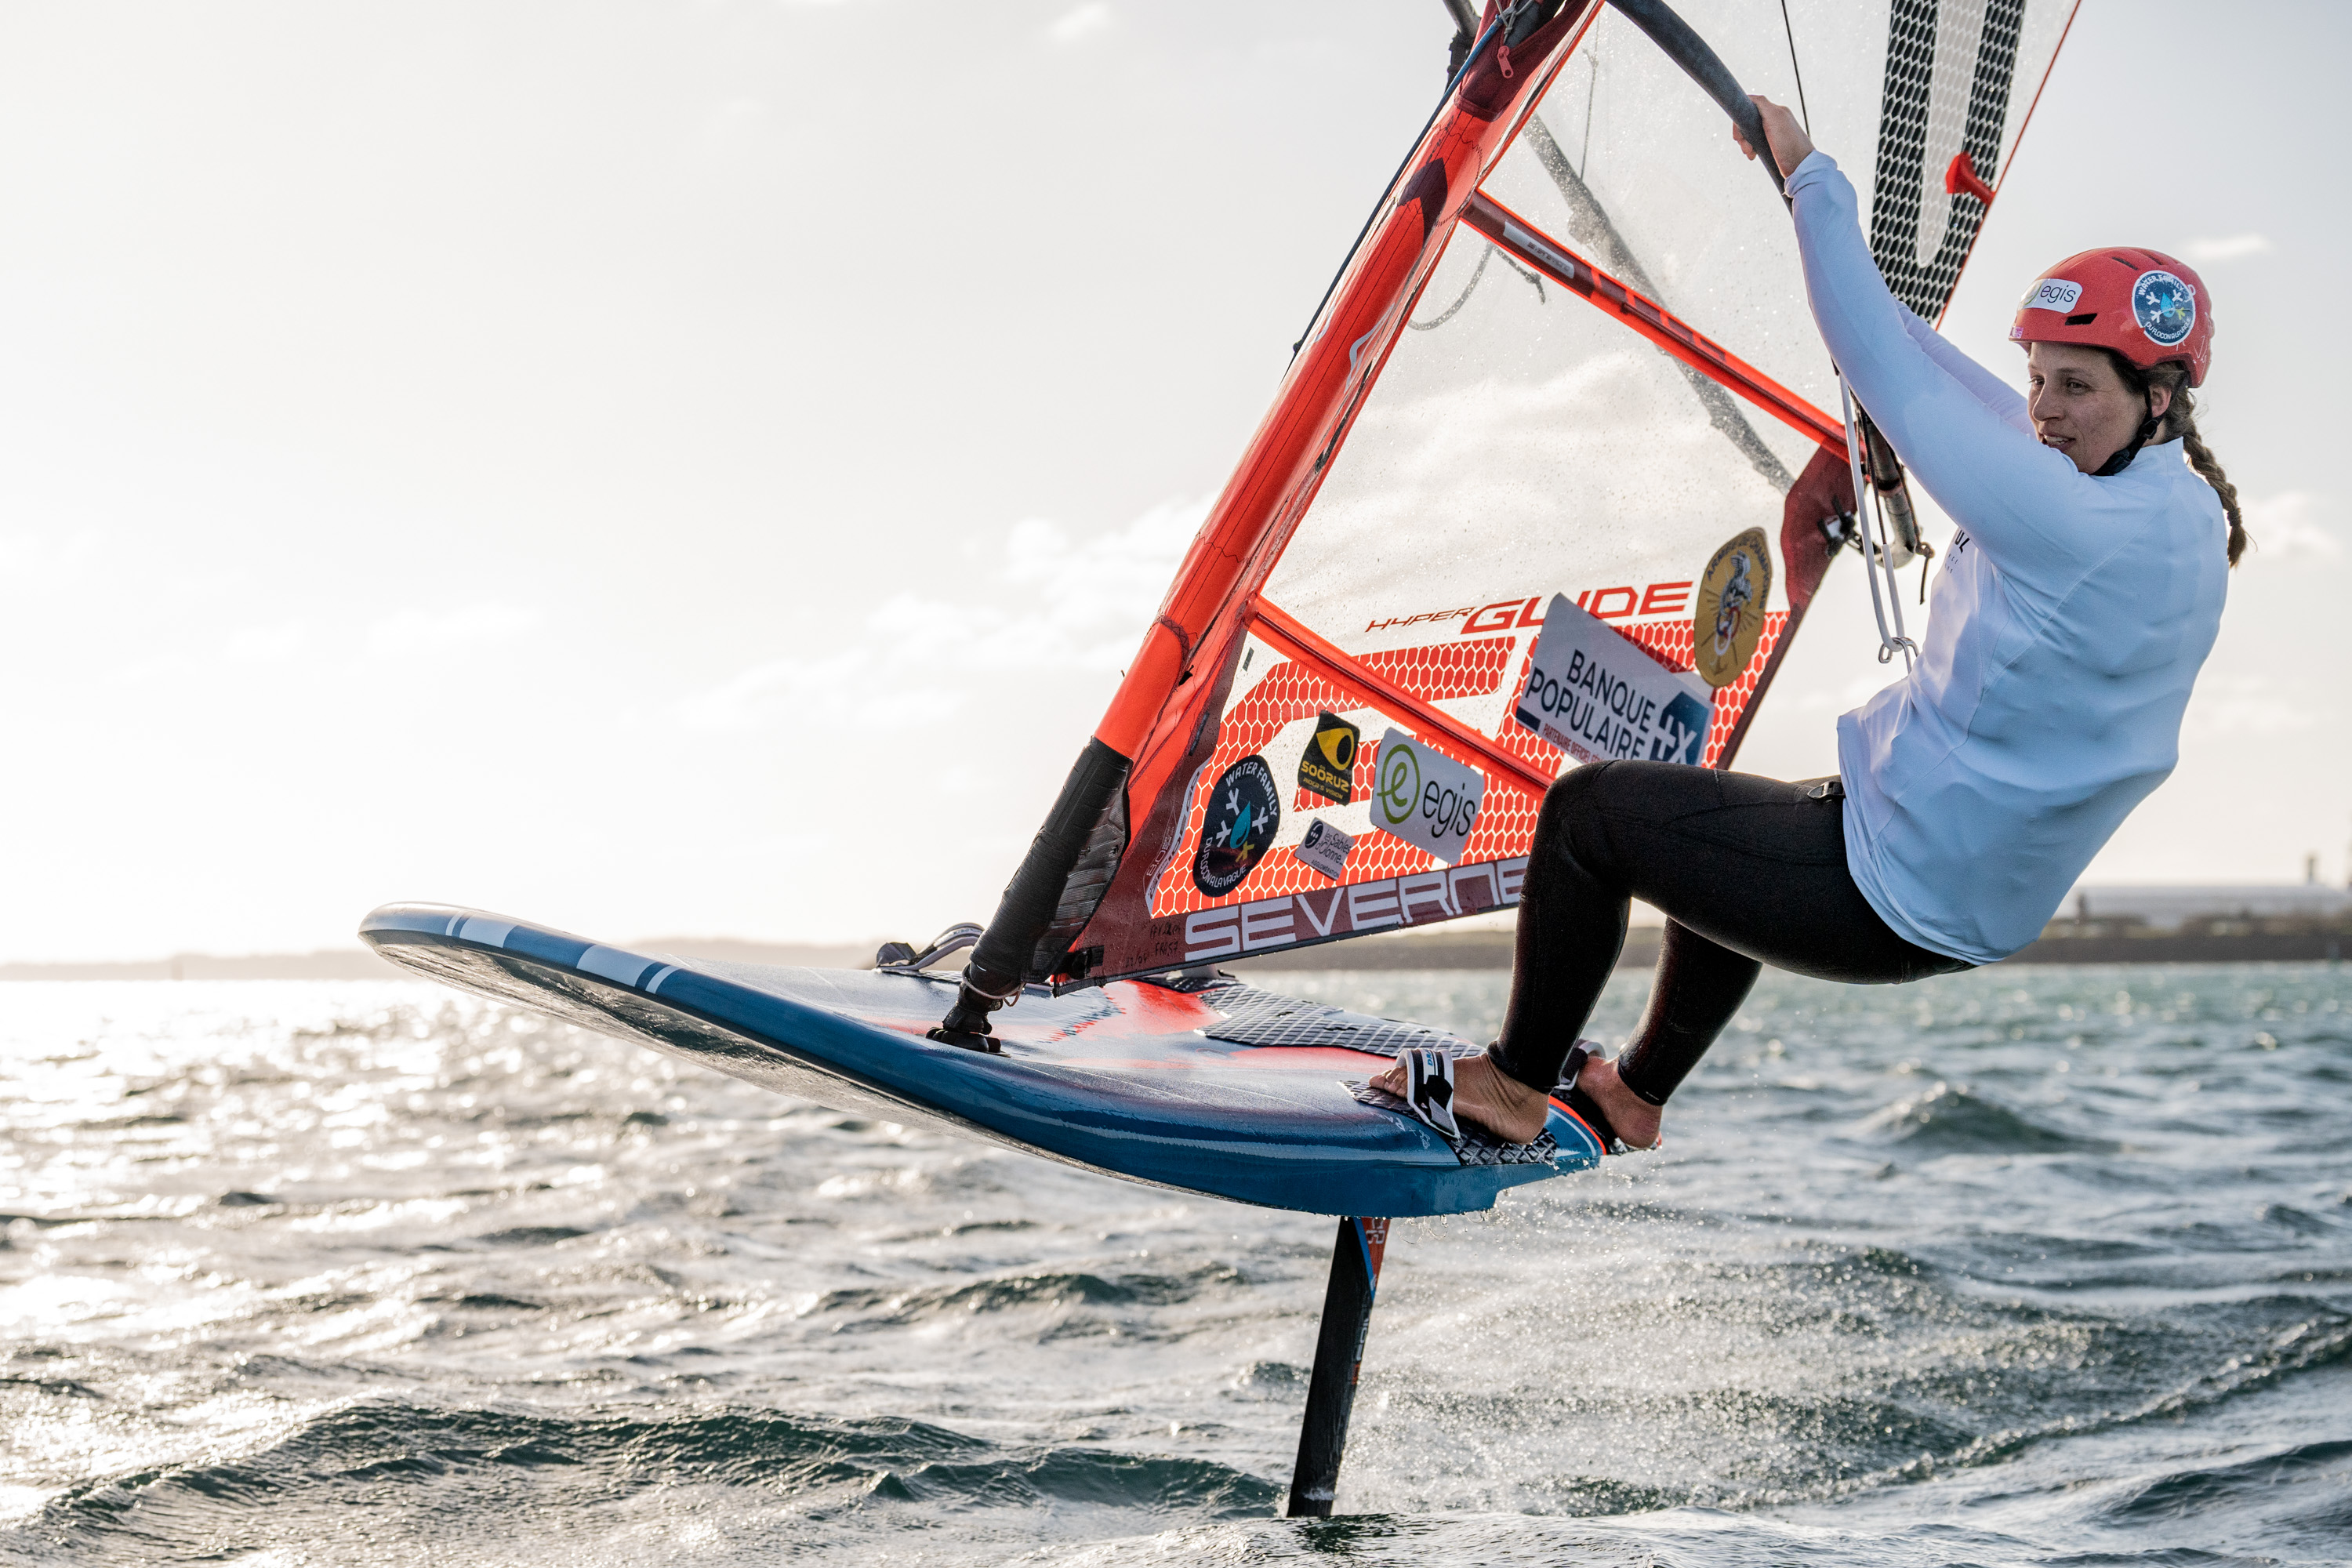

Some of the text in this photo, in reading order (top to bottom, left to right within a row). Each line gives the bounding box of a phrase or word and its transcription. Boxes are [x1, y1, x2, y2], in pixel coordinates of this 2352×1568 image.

[2040, 285, 2076, 303] egis
[2138, 274, 2184, 296] WATER FAMILY
[1526, 667, 1646, 760] POPULAIRE
[1567, 648, 1656, 733] BANQUE
[1543, 723, 1591, 764] PARTENAIRE OFFICIEL
[1225, 761, 1277, 817] WATER FAMILY
[1326, 787, 1343, 799] VISION
[1422, 780, 1475, 838] egis
[1330, 833, 1352, 855] Sables
[1185, 856, 1529, 962] SEVERNE
